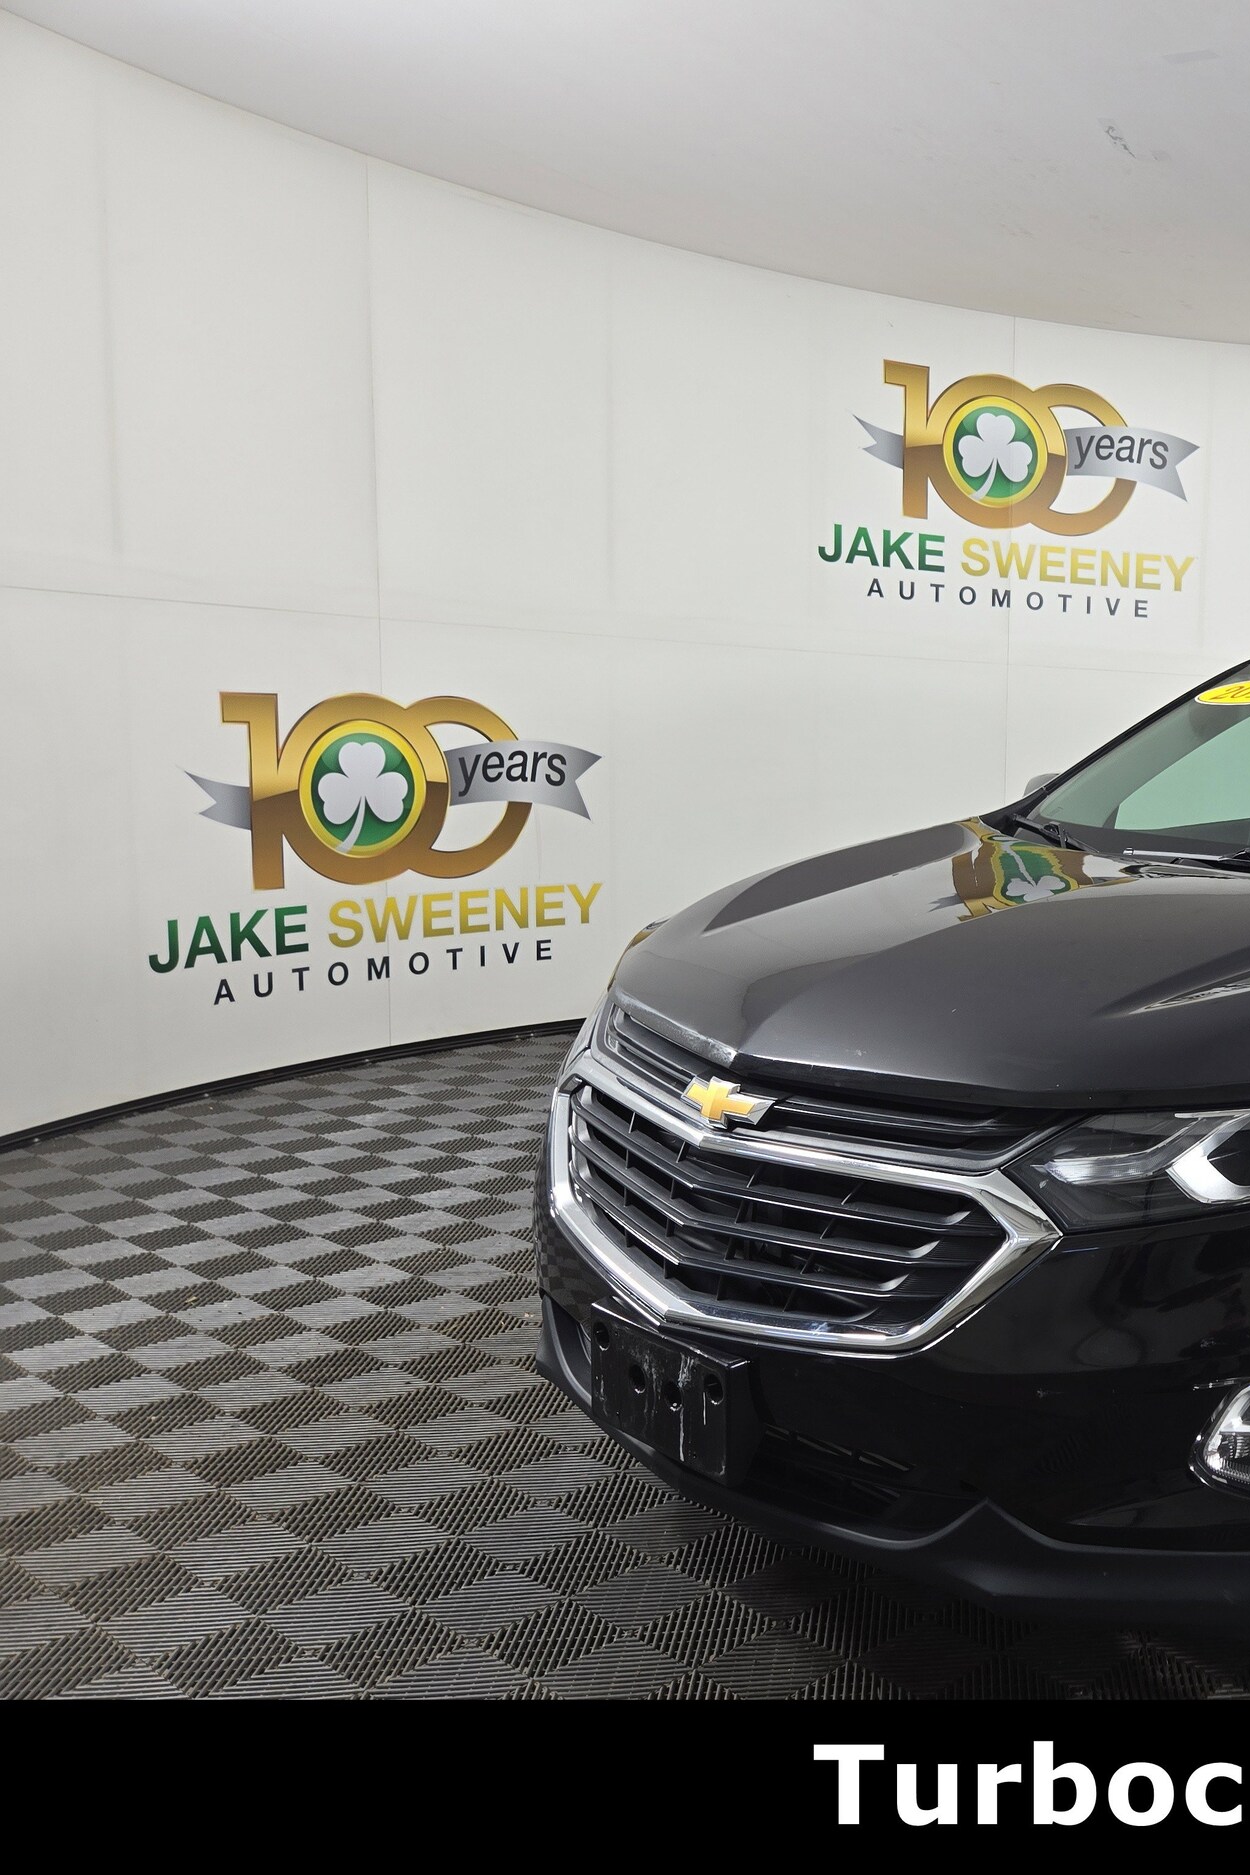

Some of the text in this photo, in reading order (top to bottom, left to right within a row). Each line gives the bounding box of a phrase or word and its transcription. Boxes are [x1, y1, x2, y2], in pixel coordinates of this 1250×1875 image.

[883, 358, 1170, 536] 100 years
[818, 523, 1196, 592] JAKE SWEENEY
[866, 578, 1149, 618] AUTOMOTIVE
[219, 691, 568, 890] 100 years
[148, 883, 603, 974] JAKE SWEENEY
[213, 939, 553, 1005] AUTOMOTIVE
